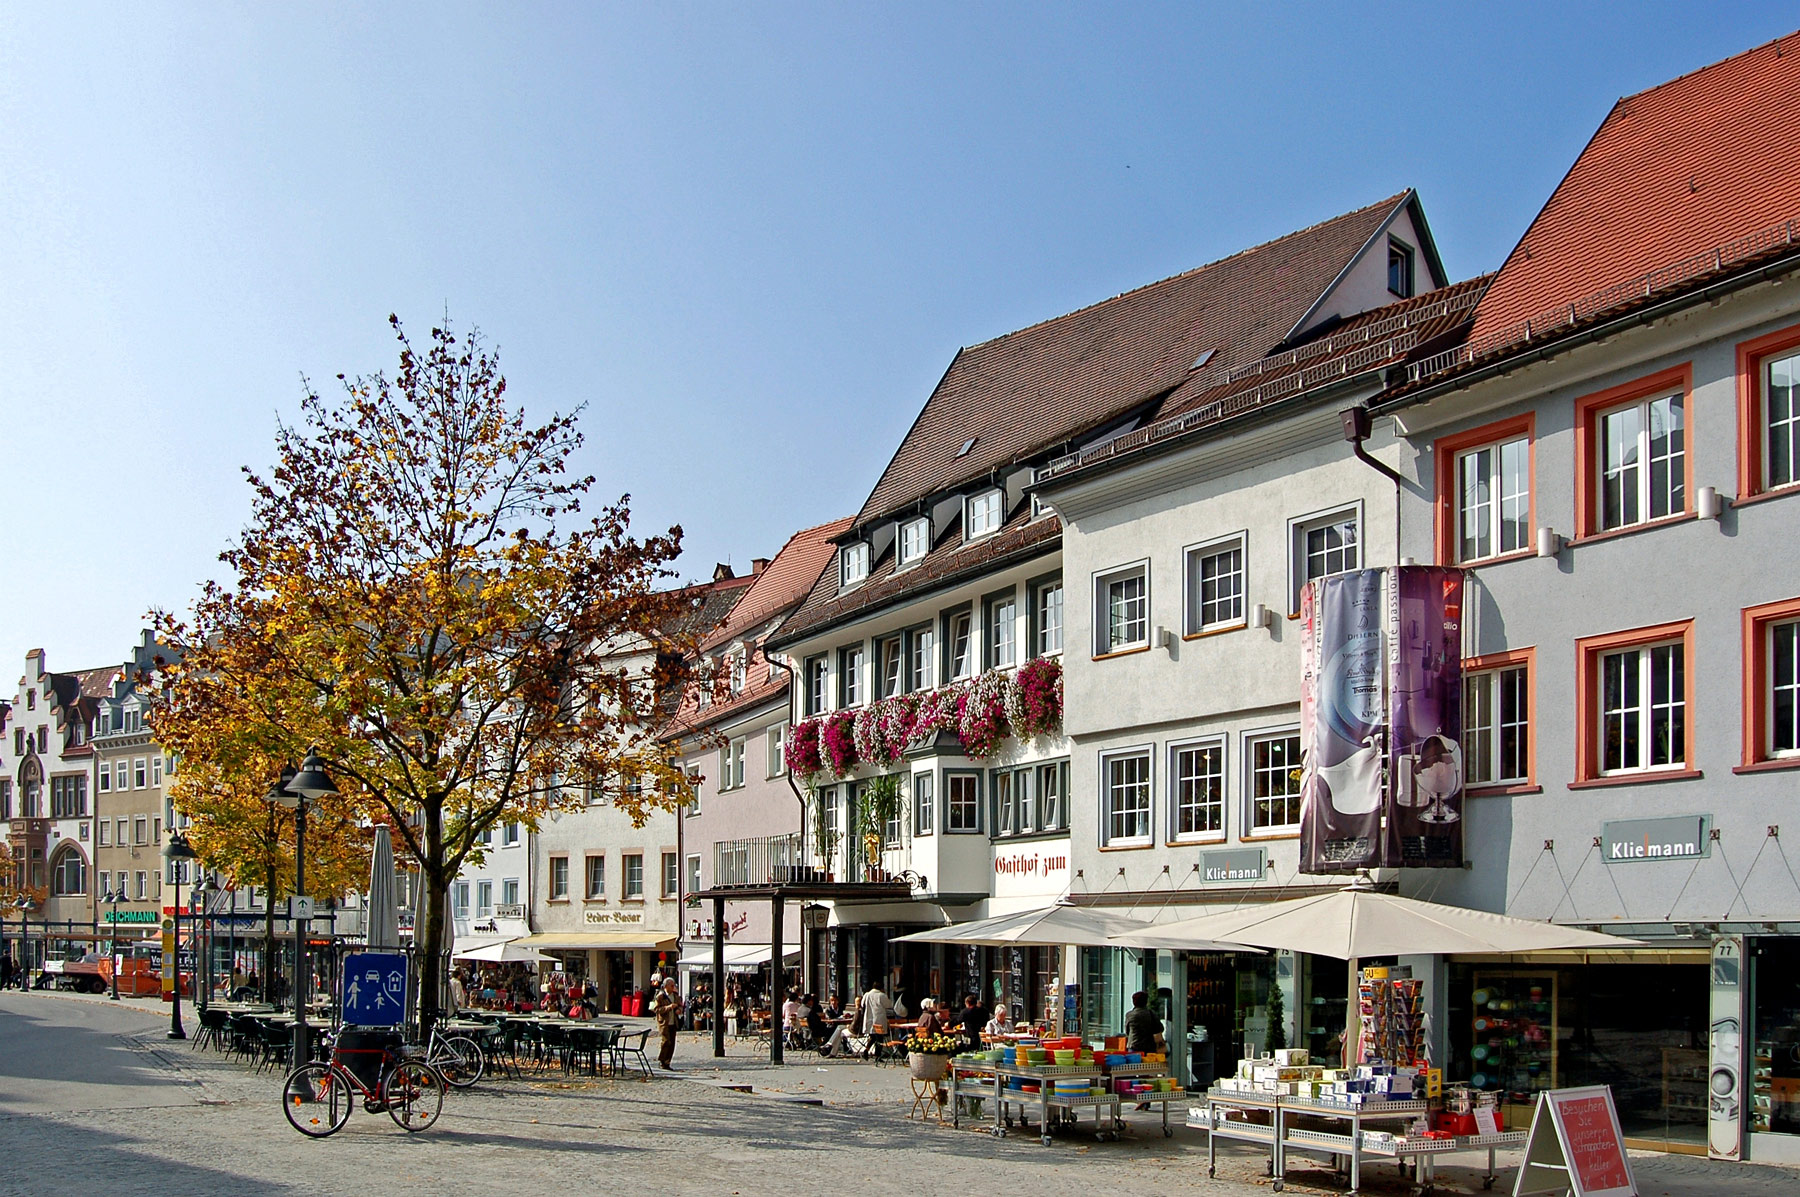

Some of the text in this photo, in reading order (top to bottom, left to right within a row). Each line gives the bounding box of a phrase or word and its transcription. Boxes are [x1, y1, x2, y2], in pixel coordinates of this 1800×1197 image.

[1389, 574, 1400, 620] passion
[1361, 710, 1378, 718] KPM
[1611, 841, 1695, 859] Kliemann
[994, 853, 1066, 879] Gasthof zum
[1206, 867, 1258, 880] Kliemann
[104, 911, 156, 922] DEICHMANN
[1720, 945, 1732, 956] 77
[1365, 969, 1374, 978] GU
[1562, 1099, 1604, 1116] Besuchen
[1578, 1117, 1592, 1126] Sie
